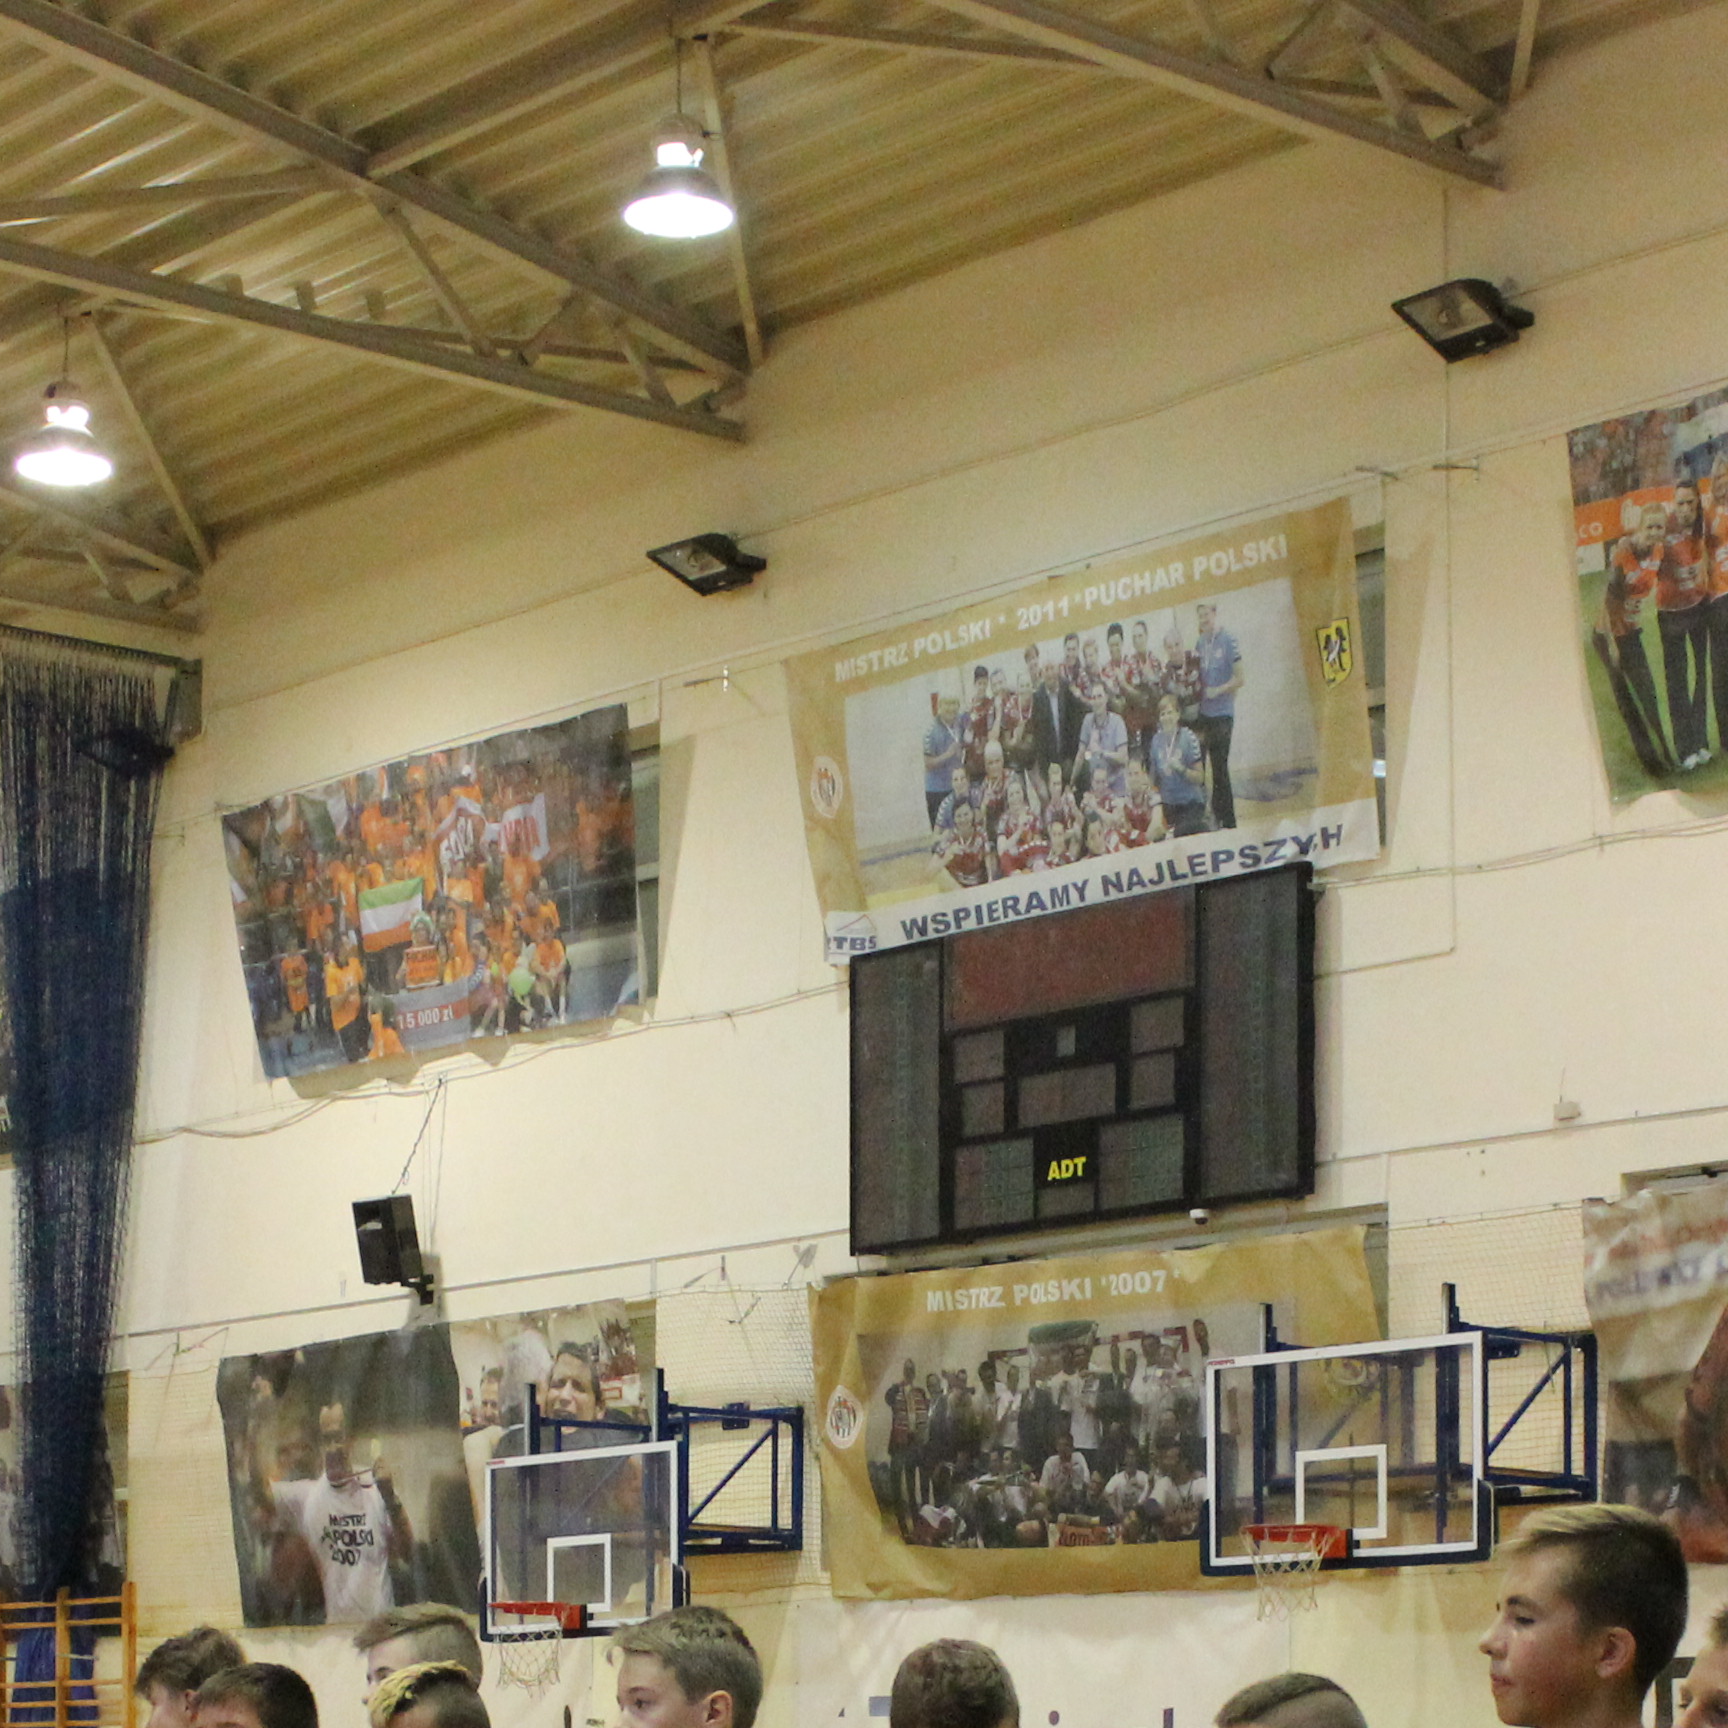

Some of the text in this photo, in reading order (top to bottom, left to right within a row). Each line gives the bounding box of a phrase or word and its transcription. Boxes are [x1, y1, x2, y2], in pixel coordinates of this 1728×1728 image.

[834, 533, 1289, 682] MISTRZ POLSKI 2011 PUCHAR POLSKI
[900, 823, 1344, 941] WSPIERAMY NAJLEPSZYH
[1047, 1155, 1088, 1181] ADT
[926, 1285, 1006, 1313] MISTRZ
[1013, 1277, 1092, 1306] POLSKI
